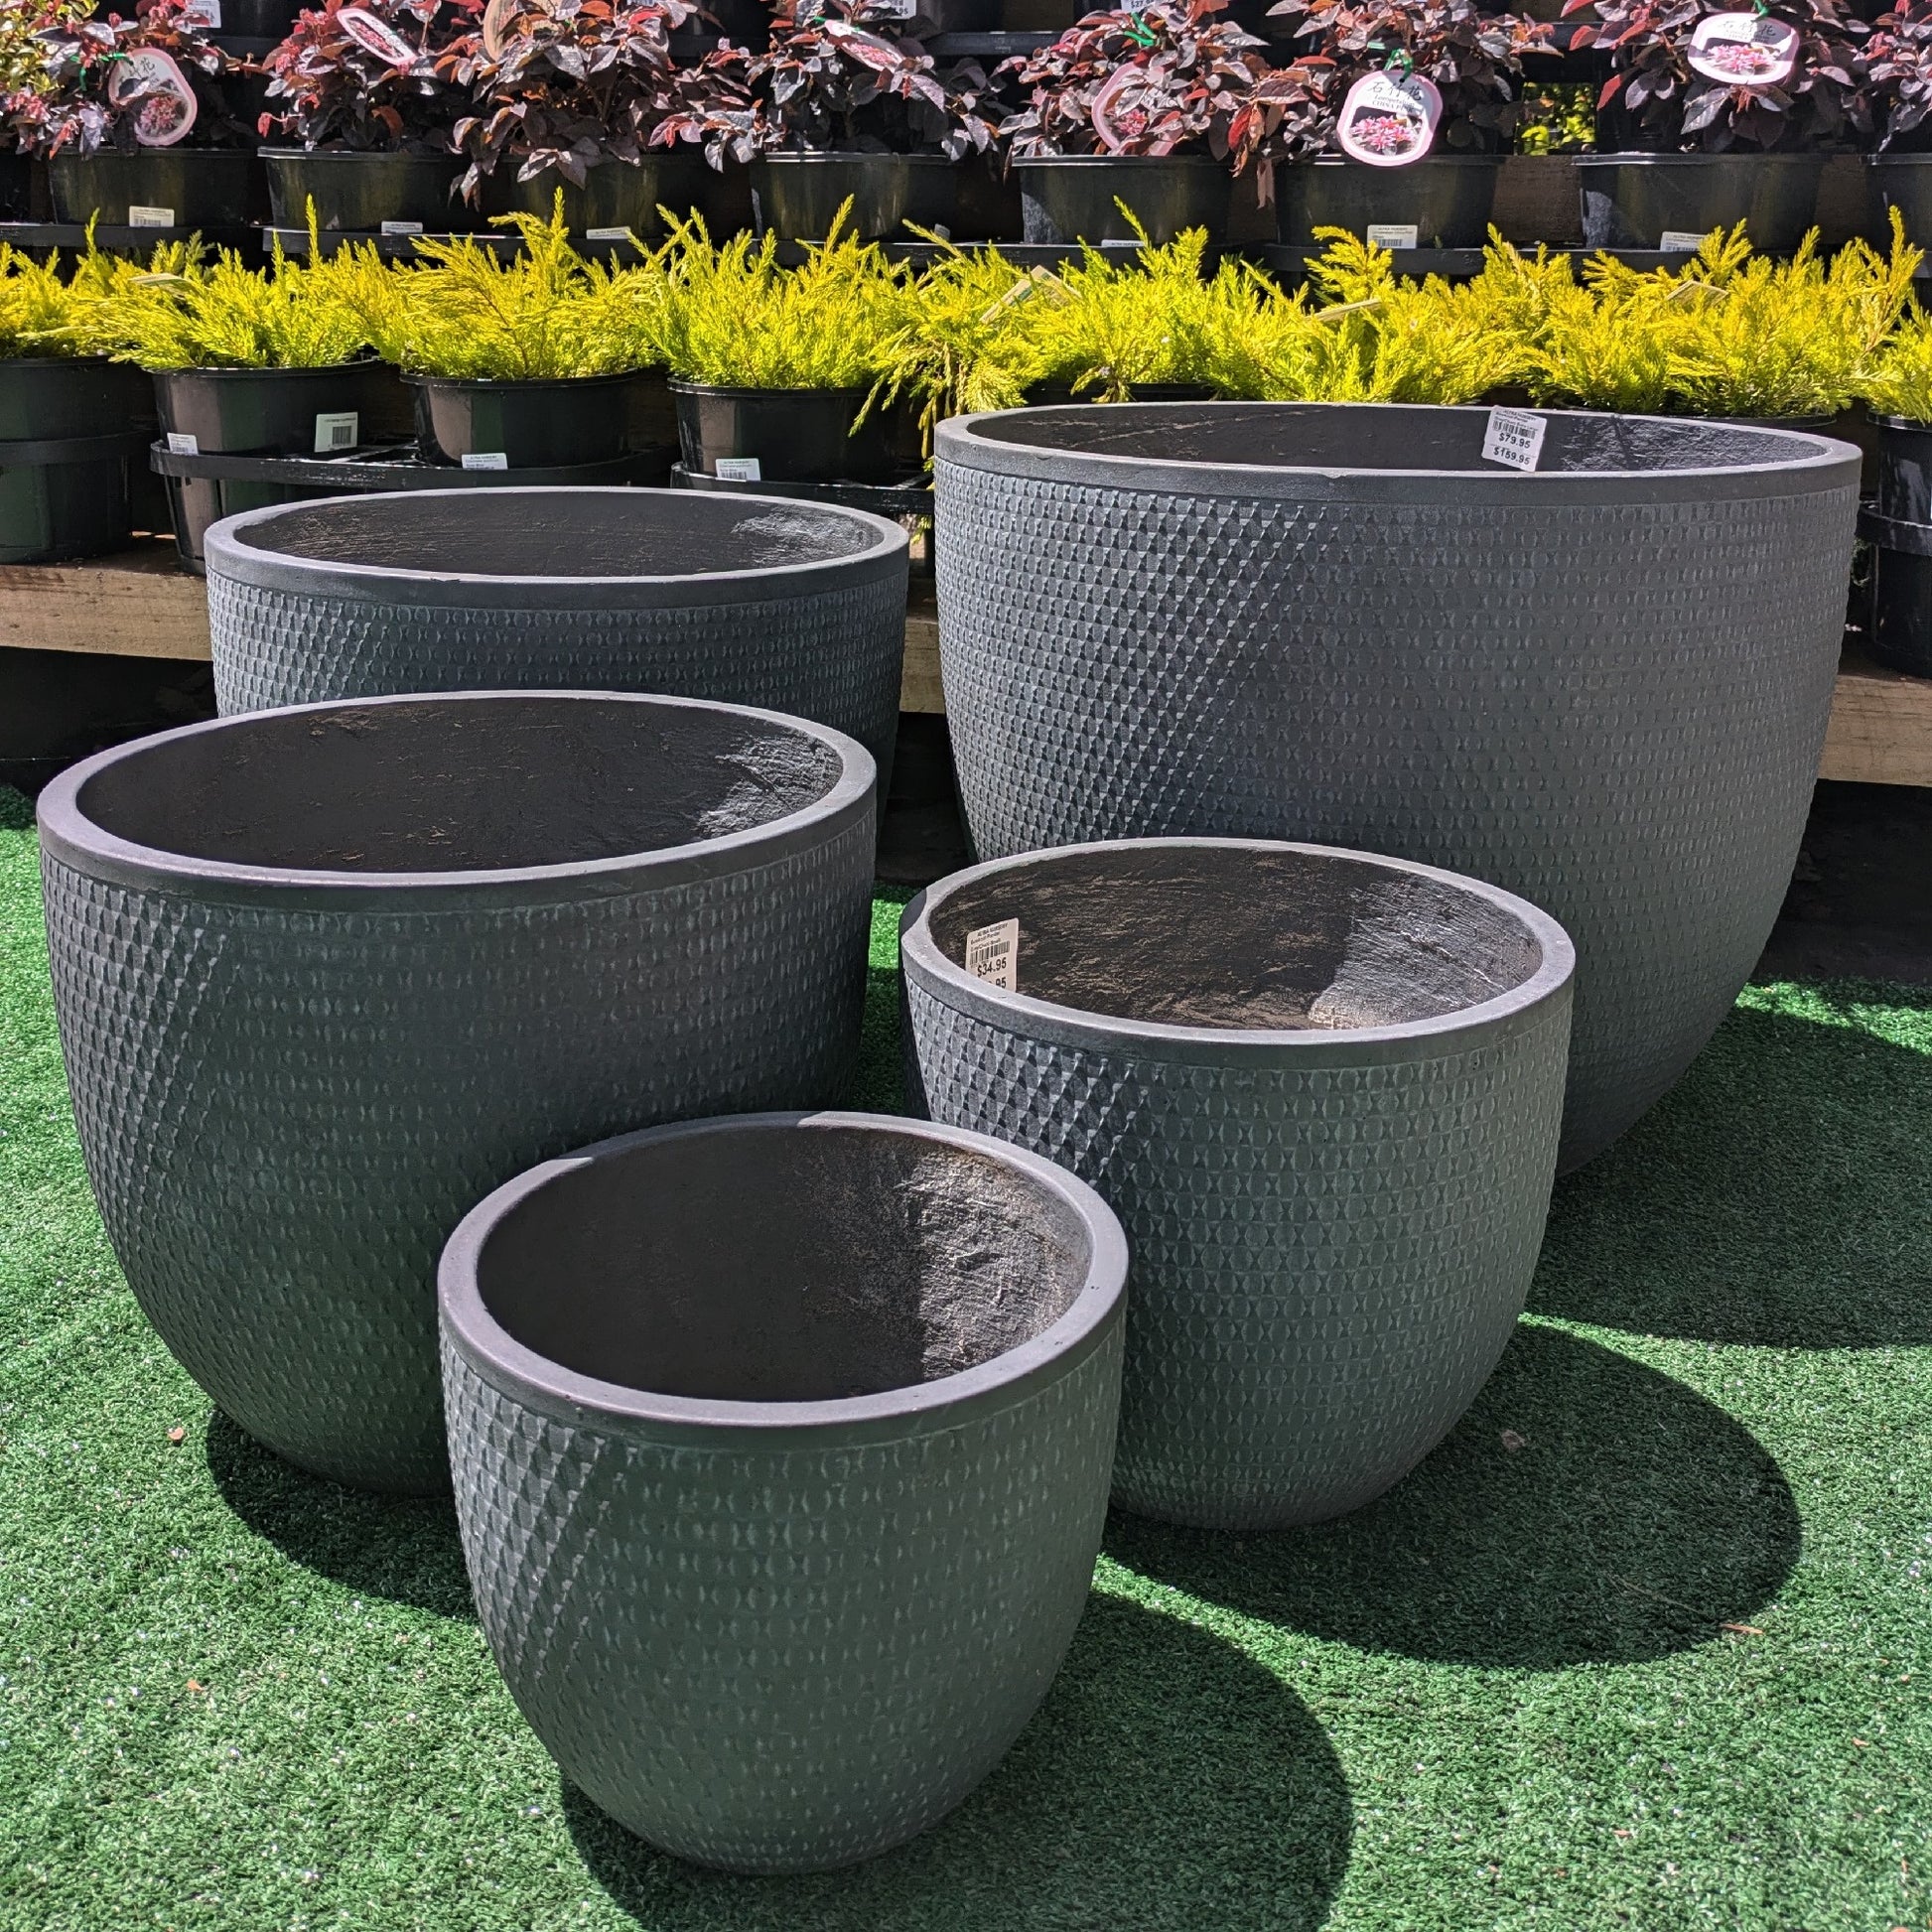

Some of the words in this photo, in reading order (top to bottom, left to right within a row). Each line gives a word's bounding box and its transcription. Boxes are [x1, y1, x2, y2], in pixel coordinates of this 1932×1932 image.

[1498, 432, 1531, 449] $79.95
[1493, 447, 1531, 466] $159.95
[977, 957, 1008, 978] $34.95
